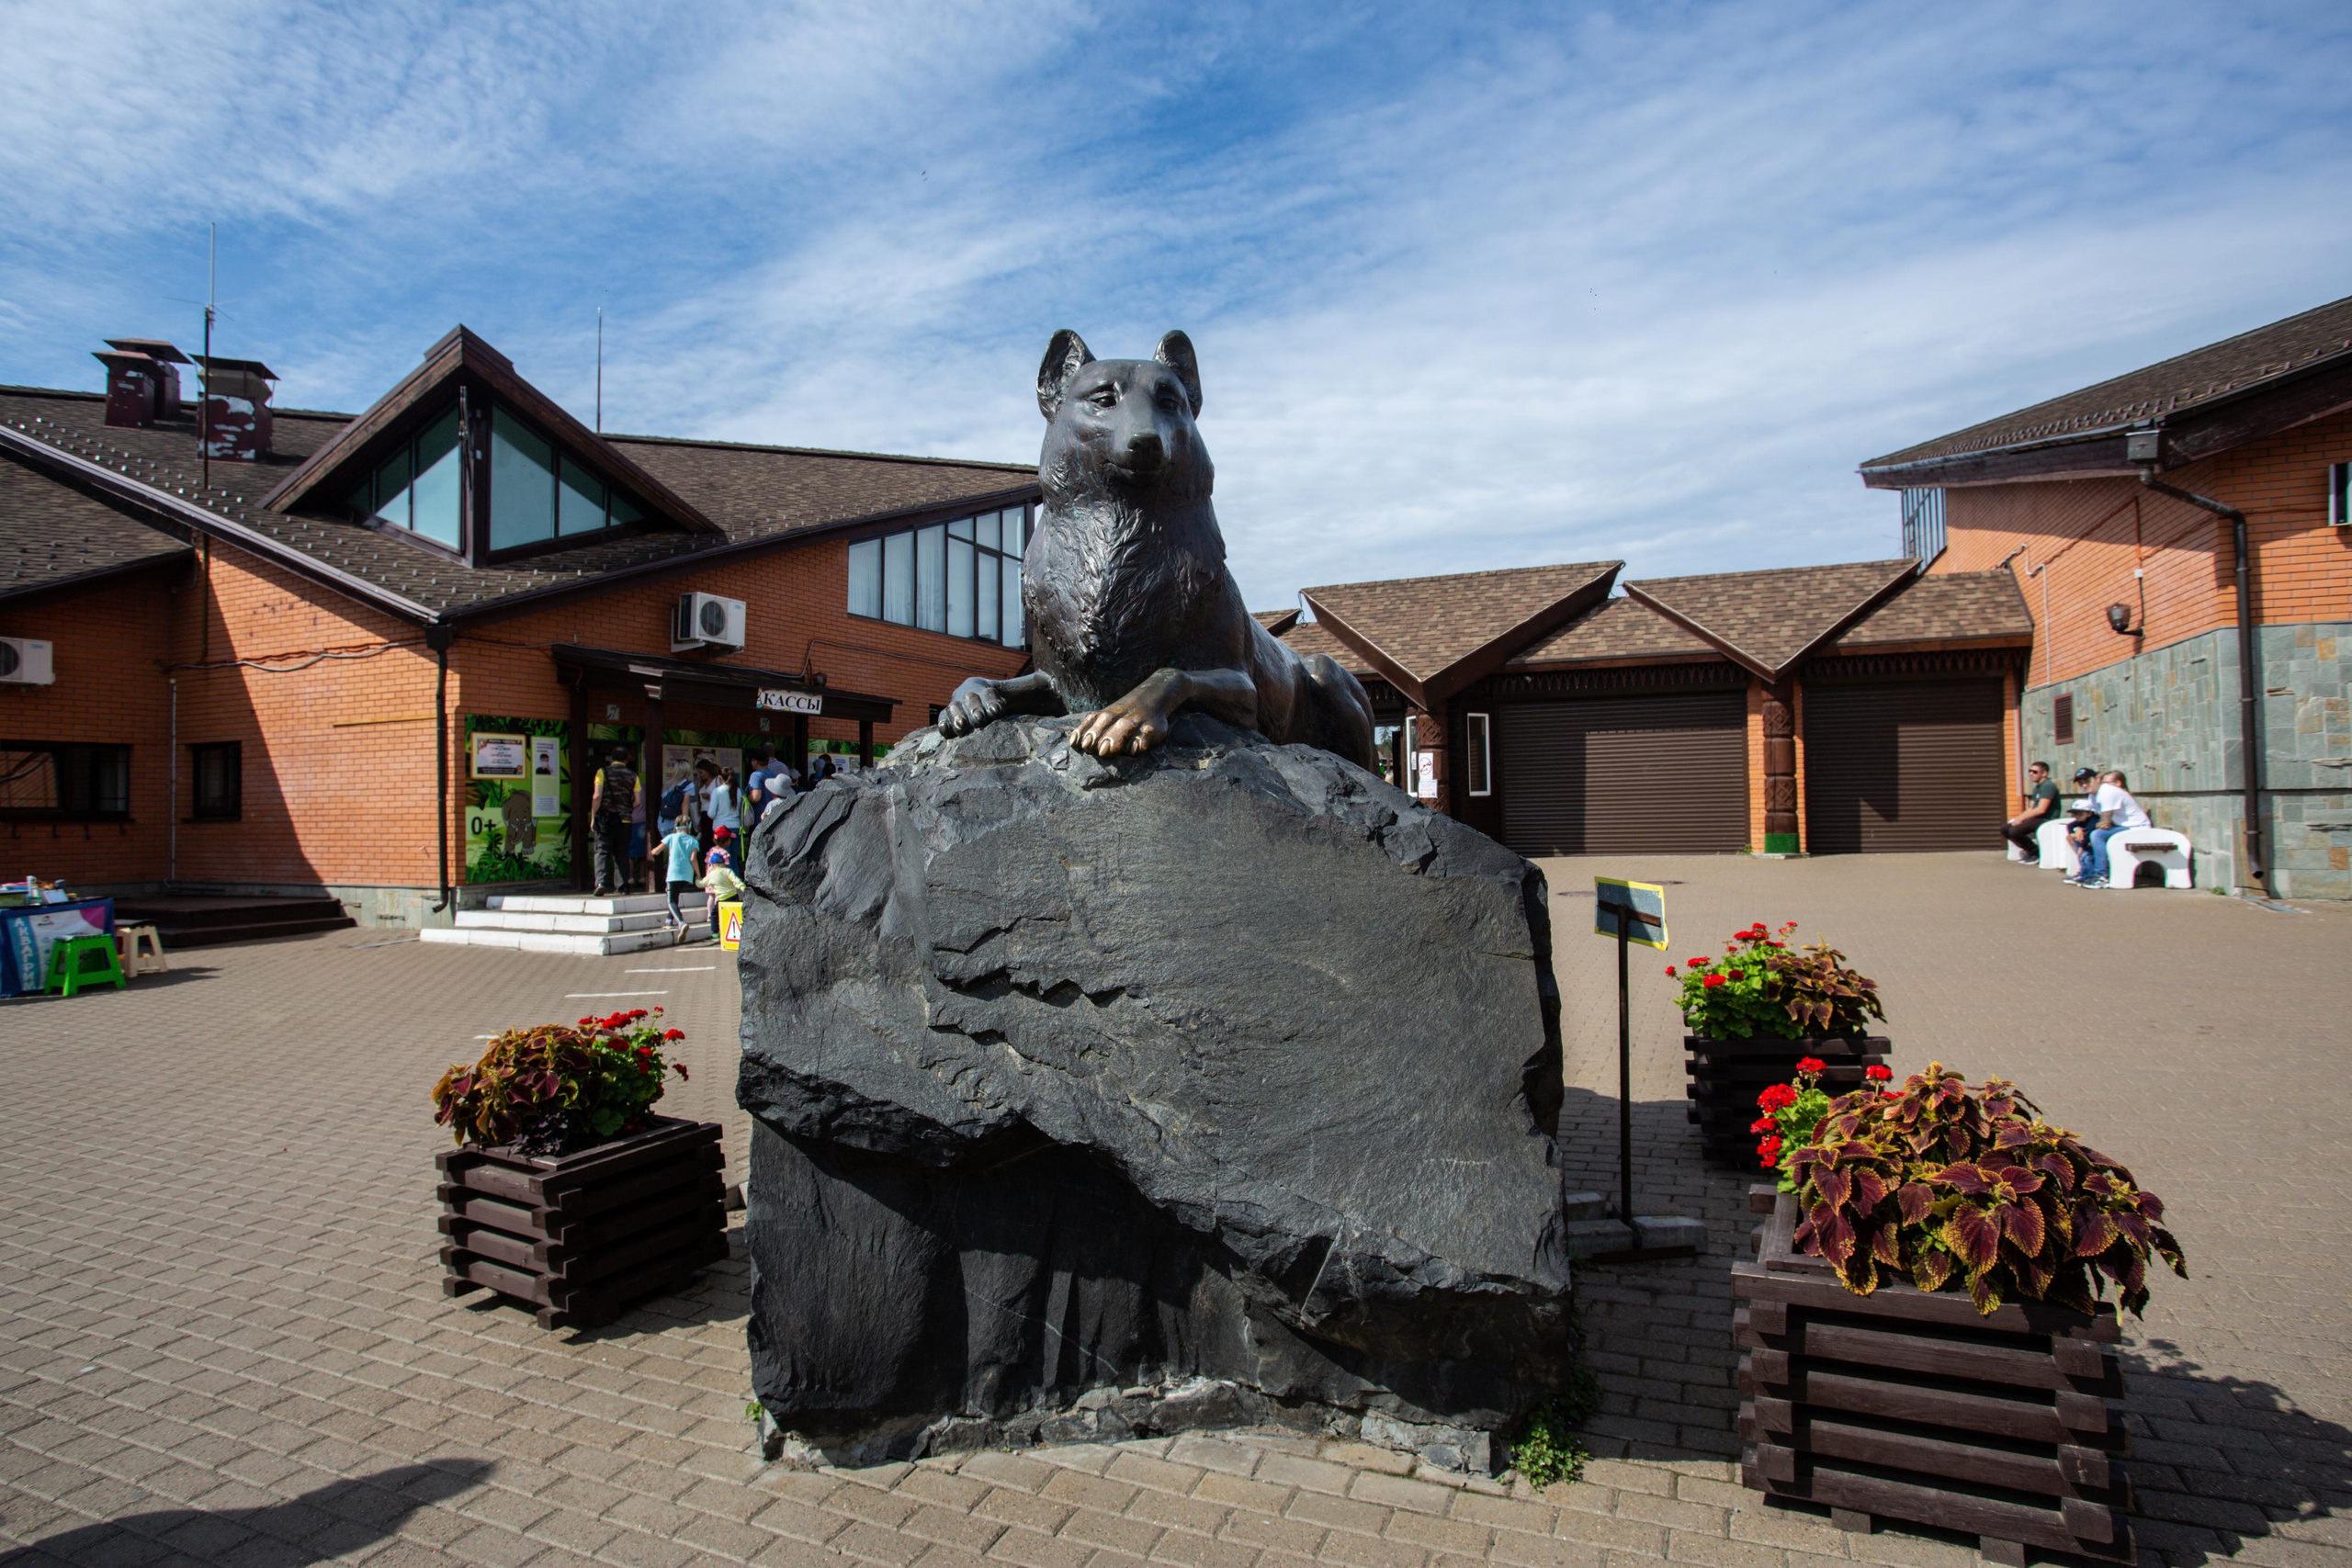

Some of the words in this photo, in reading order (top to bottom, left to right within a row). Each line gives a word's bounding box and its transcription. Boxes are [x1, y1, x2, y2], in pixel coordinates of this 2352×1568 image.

[763, 693, 820, 711] КАССЫ
[471, 816, 496, 835] 0+
[15, 918, 36, 990] АКВАГРИМ
